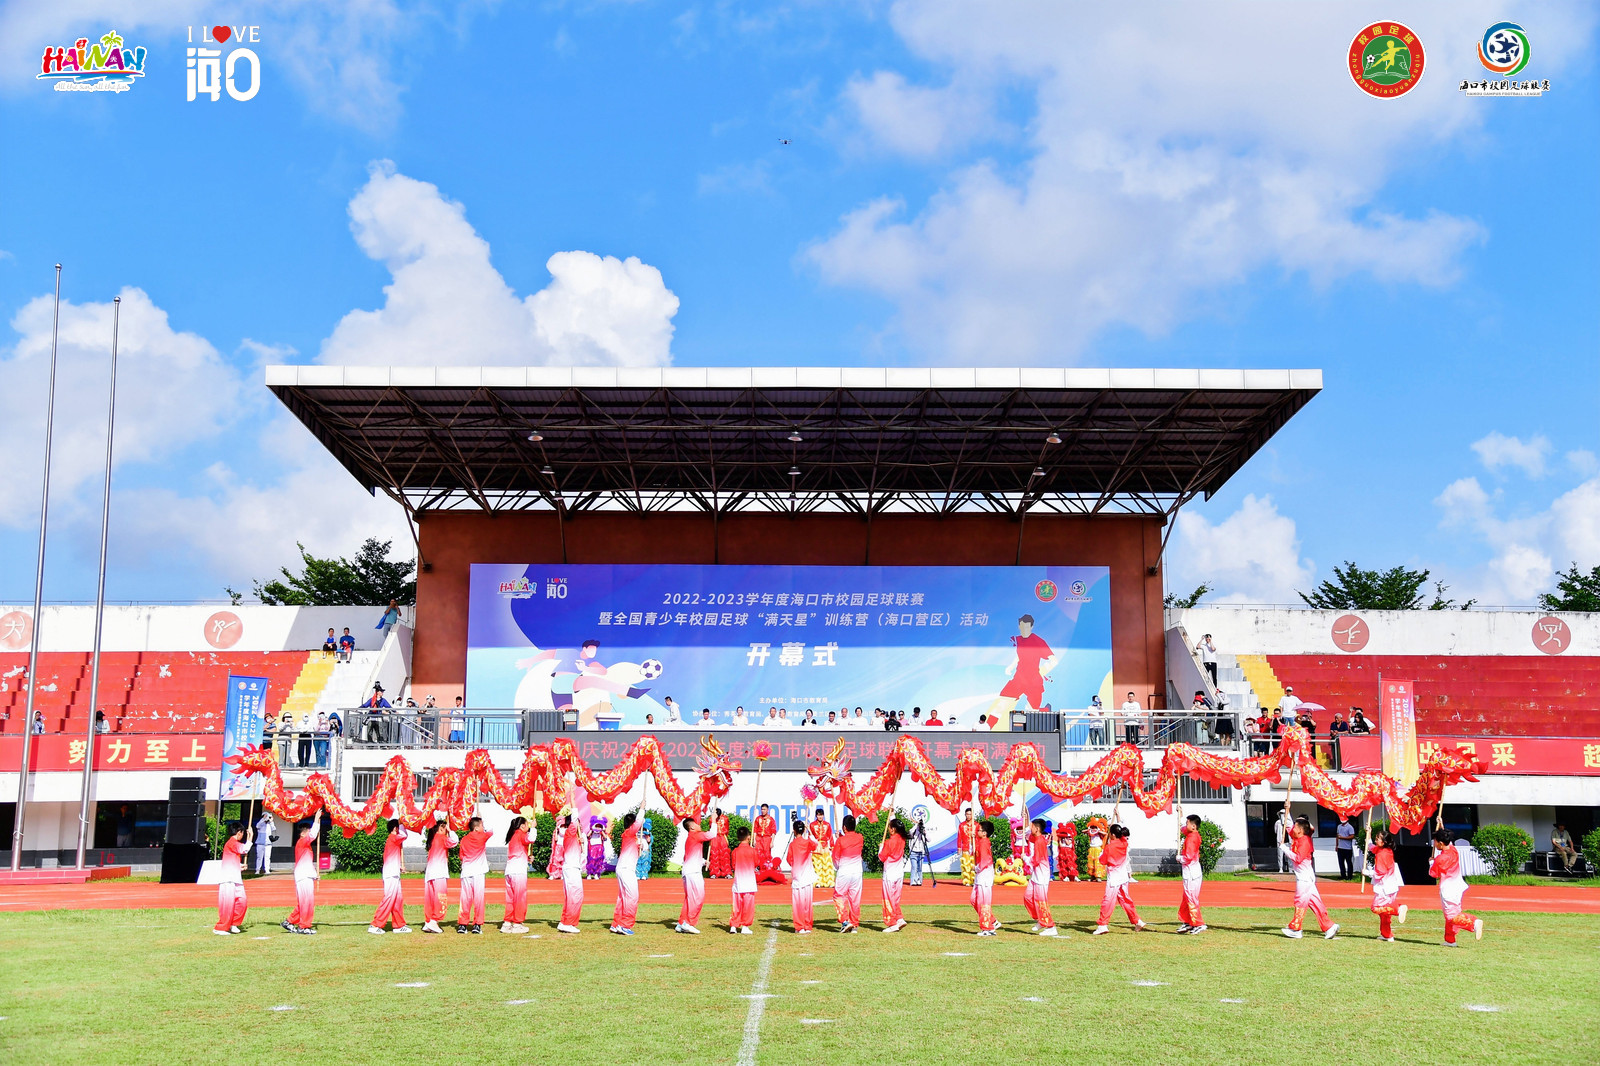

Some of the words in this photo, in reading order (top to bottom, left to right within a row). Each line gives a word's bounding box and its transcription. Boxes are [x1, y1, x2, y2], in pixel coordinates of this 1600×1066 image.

[663, 592, 925, 607] 2022-2023学年度海口市校园足球联赛
[746, 642, 839, 667] 开幕式
[68, 738, 207, 765] 努力至上
